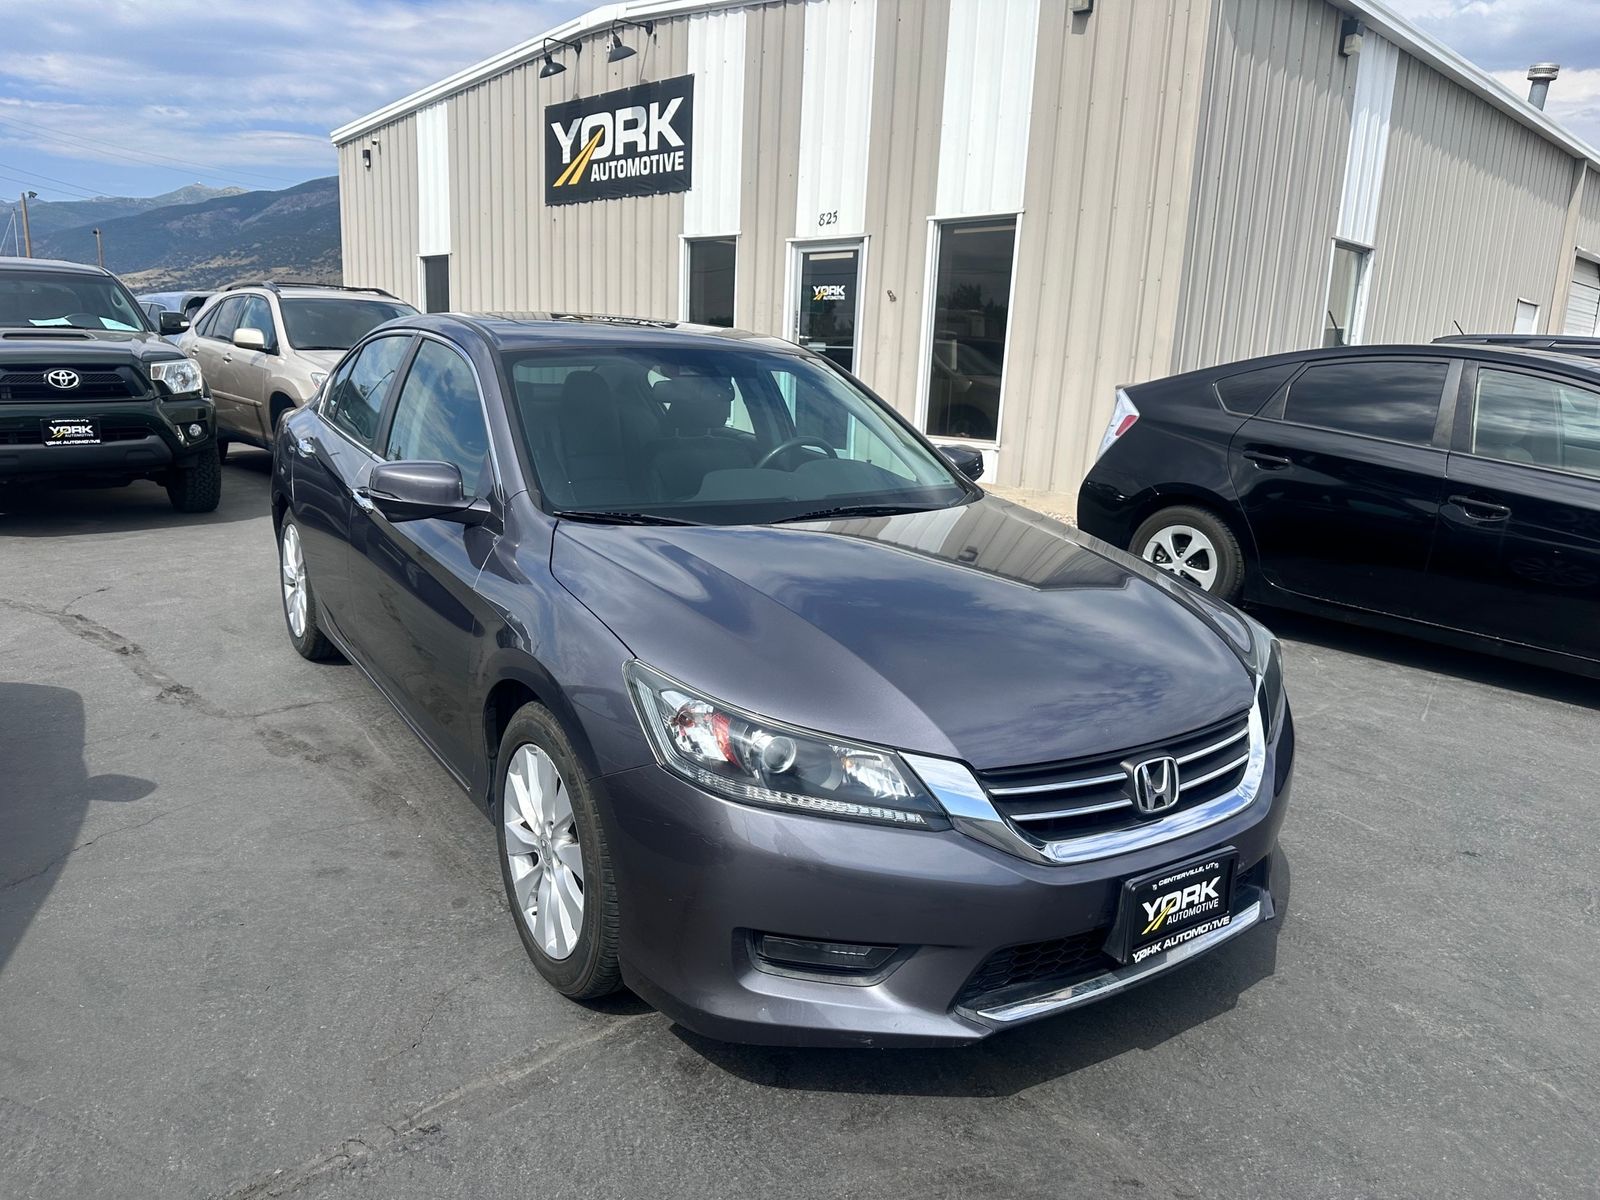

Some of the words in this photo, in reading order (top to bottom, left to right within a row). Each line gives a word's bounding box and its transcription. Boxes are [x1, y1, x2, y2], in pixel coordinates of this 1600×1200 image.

[551, 97, 685, 164] YORK
[590, 150, 684, 182] AUTOMOTIVE
[818, 210, 838, 226] 825
[813, 285, 846, 296] YORK
[48, 425, 93, 434] YORK
[1158, 866, 1205, 886] CENTERVILLE,
[1142, 876, 1221, 922] YORK
[1166, 898, 1219, 925] AUTOMOTIVE
[1132, 942, 1162, 963] YORK
[1163, 915, 1230, 949] AUTOMOTIVE
